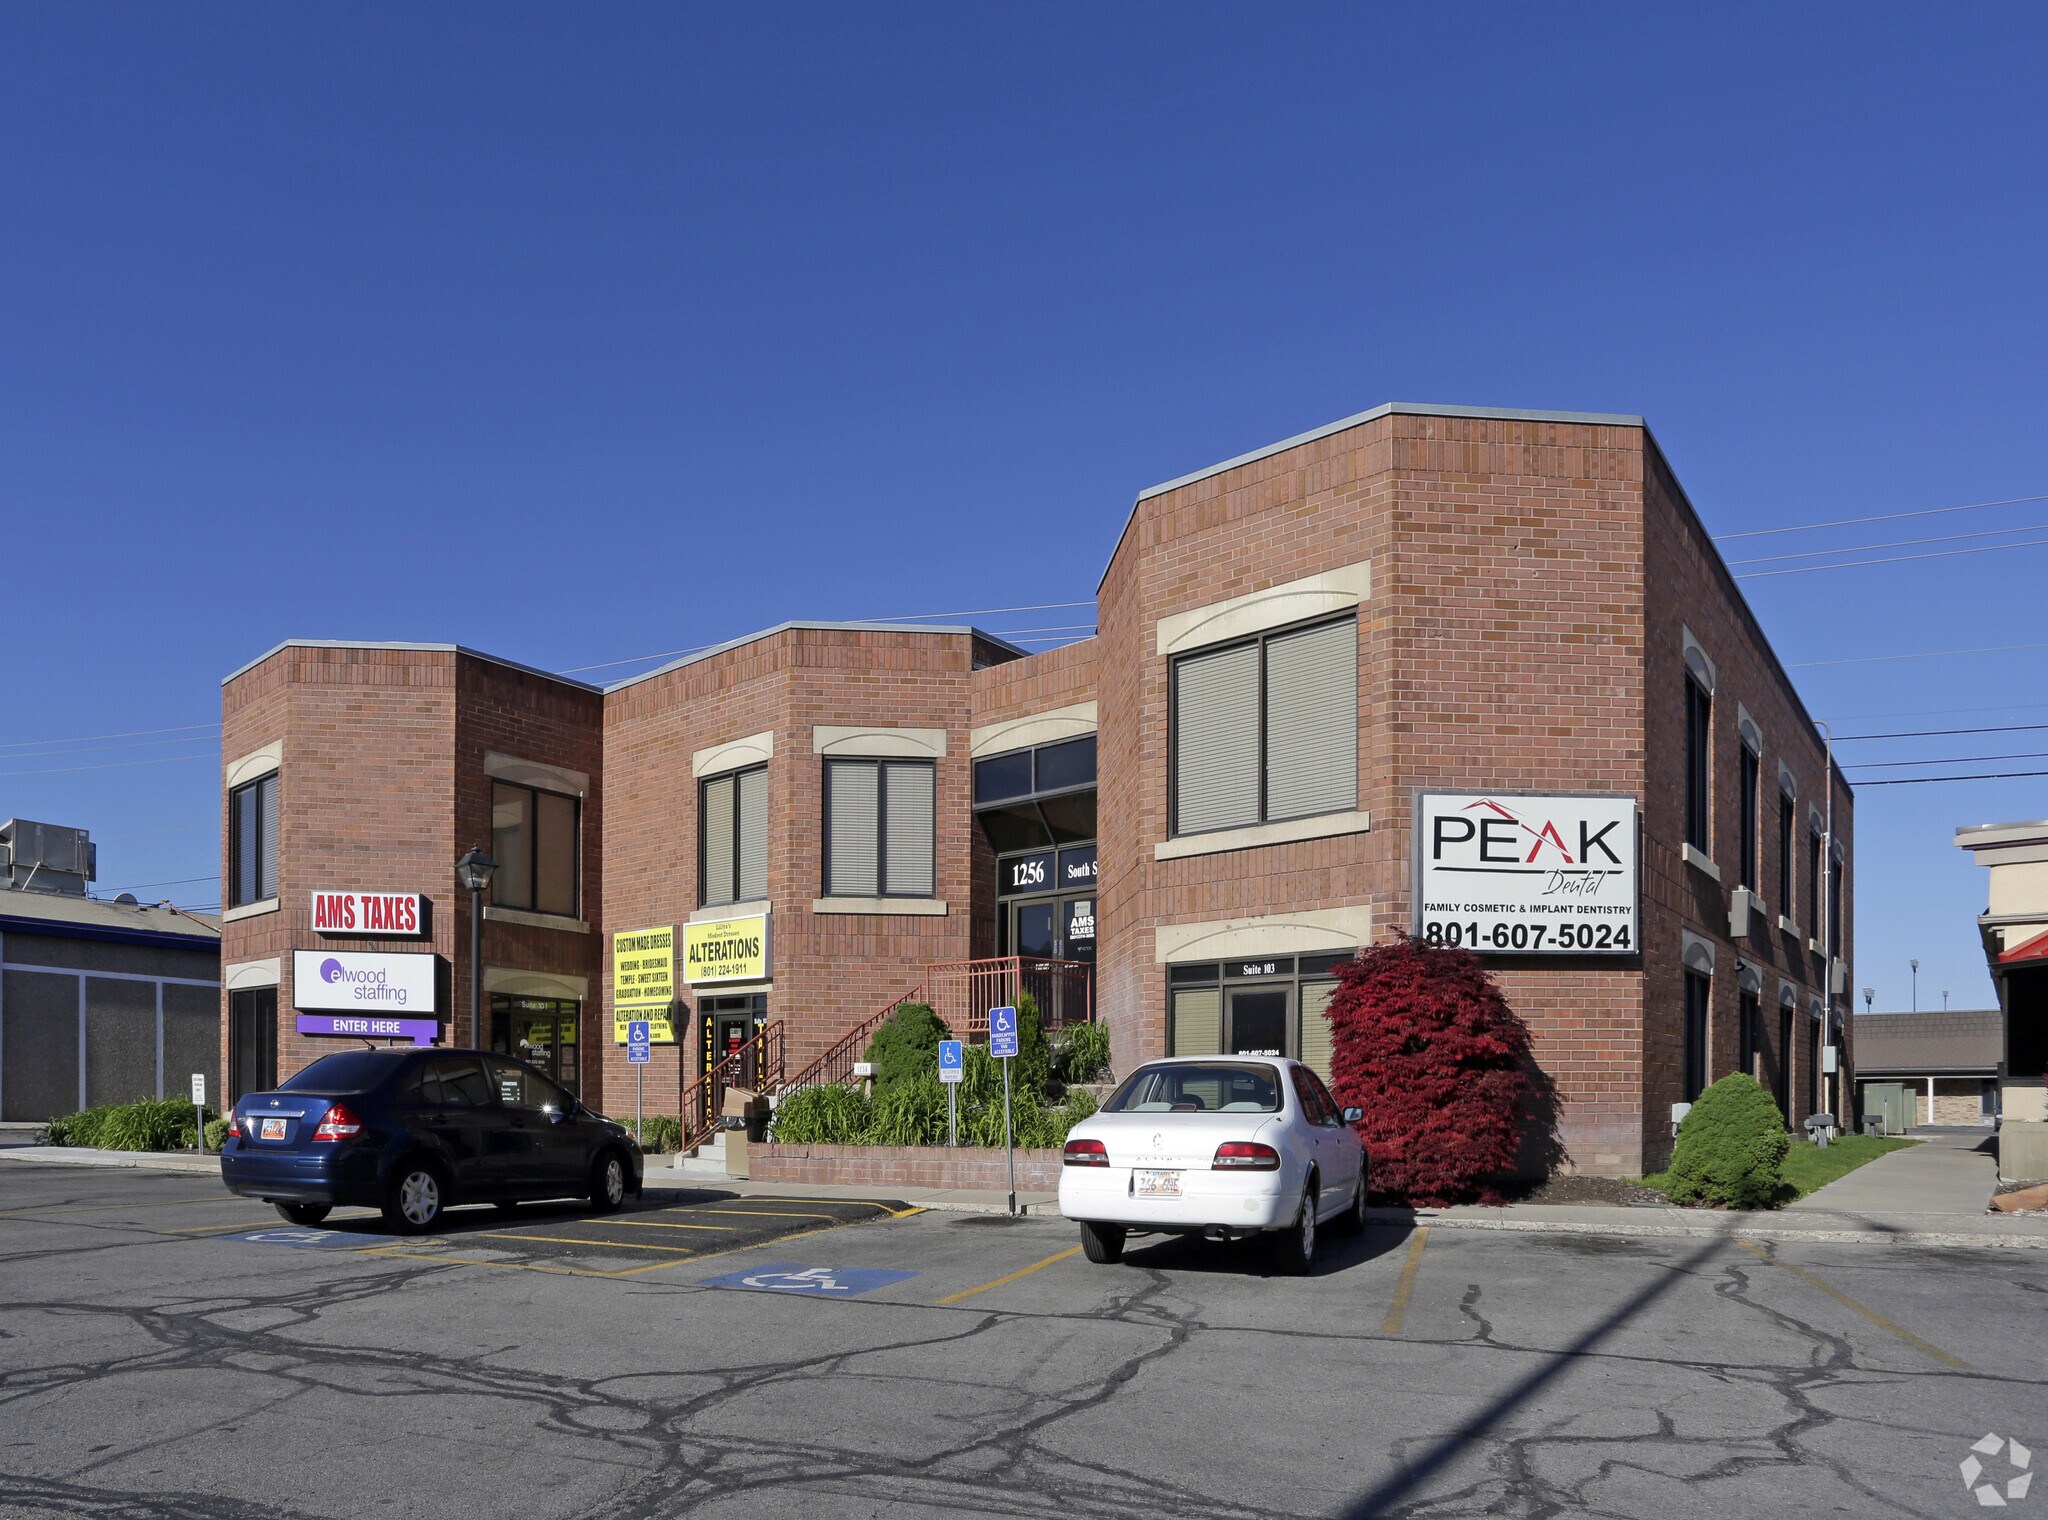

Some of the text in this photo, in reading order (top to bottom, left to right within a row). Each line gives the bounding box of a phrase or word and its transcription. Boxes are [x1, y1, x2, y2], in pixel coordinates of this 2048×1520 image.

[1433, 815, 1623, 865] PEAK
[1012, 860, 1045, 886] 1256
[1067, 862, 1090, 879] South
[1541, 868, 1607, 897] Dental
[314, 894, 416, 931] AMS TAXES
[1424, 903, 1632, 915] FAMILY COSMETIC & IMPLANT DENTISTRY
[1070, 915, 1095, 928] AMS
[1070, 926, 1094, 935] TAXES
[1426, 921, 1631, 950] 801-607-5024
[616, 933, 672, 953] CUSTOM MADE DRESSES
[689, 936, 759, 964] ALTERATIONS
[620, 960, 640, 972] WEDDING
[642, 958, 668, 970] BRIDESMAID
[700, 963, 747, 978] (801) 224-1911
[1243, 964, 1275, 976] Suite 103
[330, 966, 386, 984] elwood
[620, 974, 635, 985] TEMPLE
[638, 973, 652, 984] SWEET
[652, 972, 668, 982] SIXTEEN
[354, 984, 407, 1005] staffing
[616, 988, 641, 1000] GRADUATION
[644, 986, 672, 996] HOMECOMING
[522, 1000, 536, 1008] Suite
[616, 1008, 672, 1022] ALTERATION AND REPAIR
[333, 1020, 400, 1034] ENTER HERE
